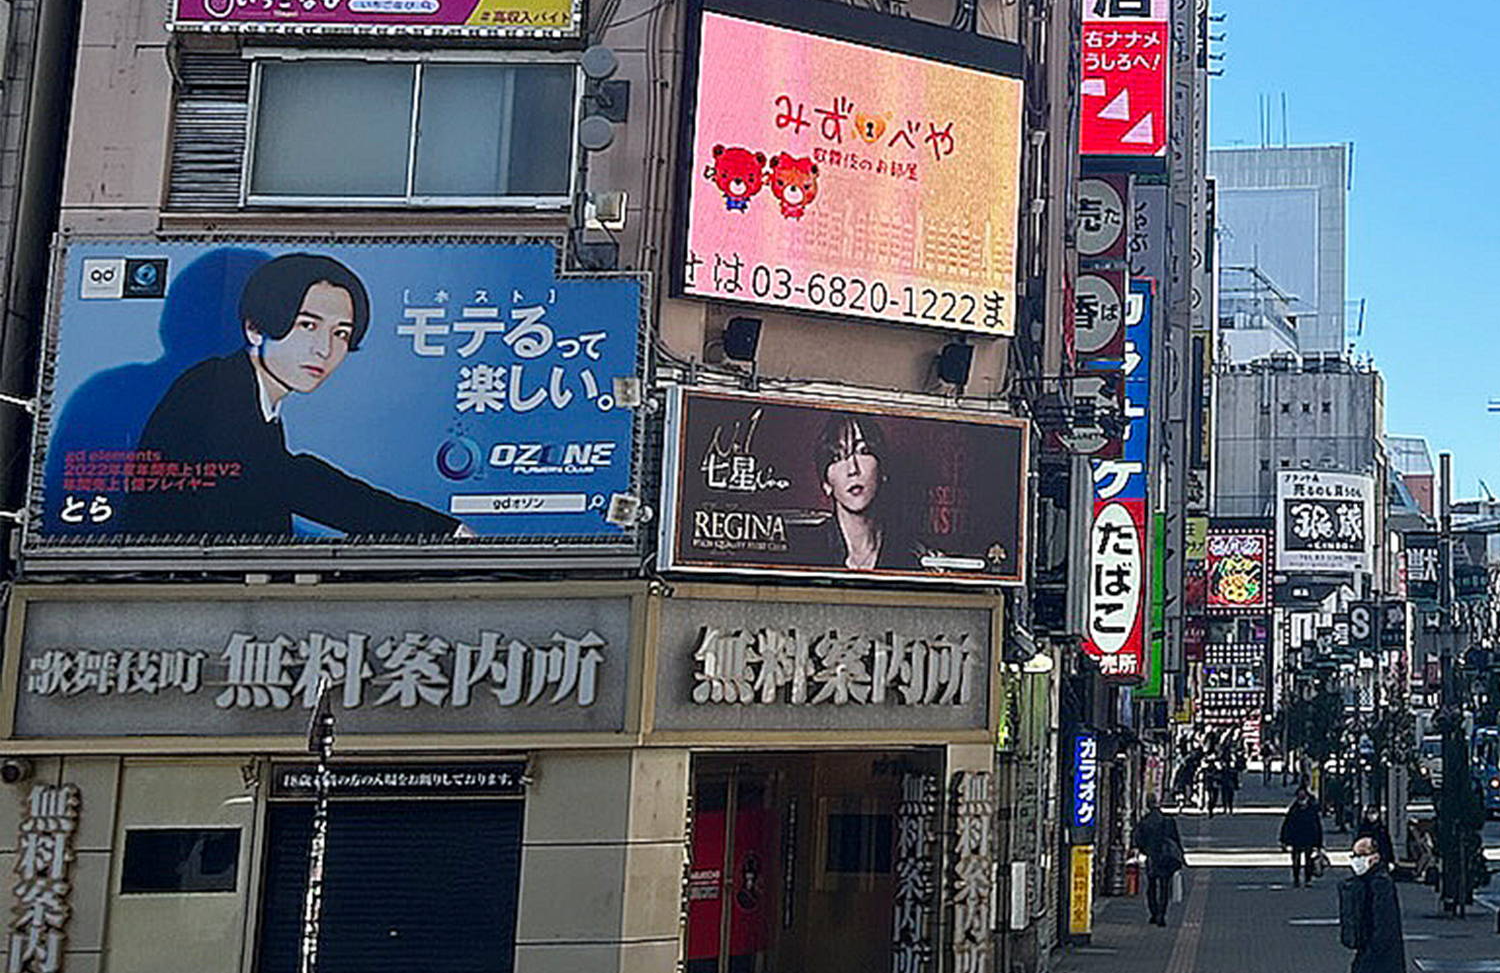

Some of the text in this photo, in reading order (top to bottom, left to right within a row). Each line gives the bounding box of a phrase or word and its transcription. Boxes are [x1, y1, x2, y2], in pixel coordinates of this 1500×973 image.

[1084, 30, 1161, 47] 右ナナメ
[888, 119, 956, 162] べや
[397, 305, 607, 360] モテるって
[456, 363, 615, 413] 楽しい。
[60, 494, 112, 523] とら
[693, 512, 788, 542] REGINA
[1092, 521, 1134, 634] たばこ
[27, 630, 607, 711] 歌舞伎町 無料案内所
[692, 624, 981, 707] 無料案内所
[1078, 737, 1097, 825] カラオケ
